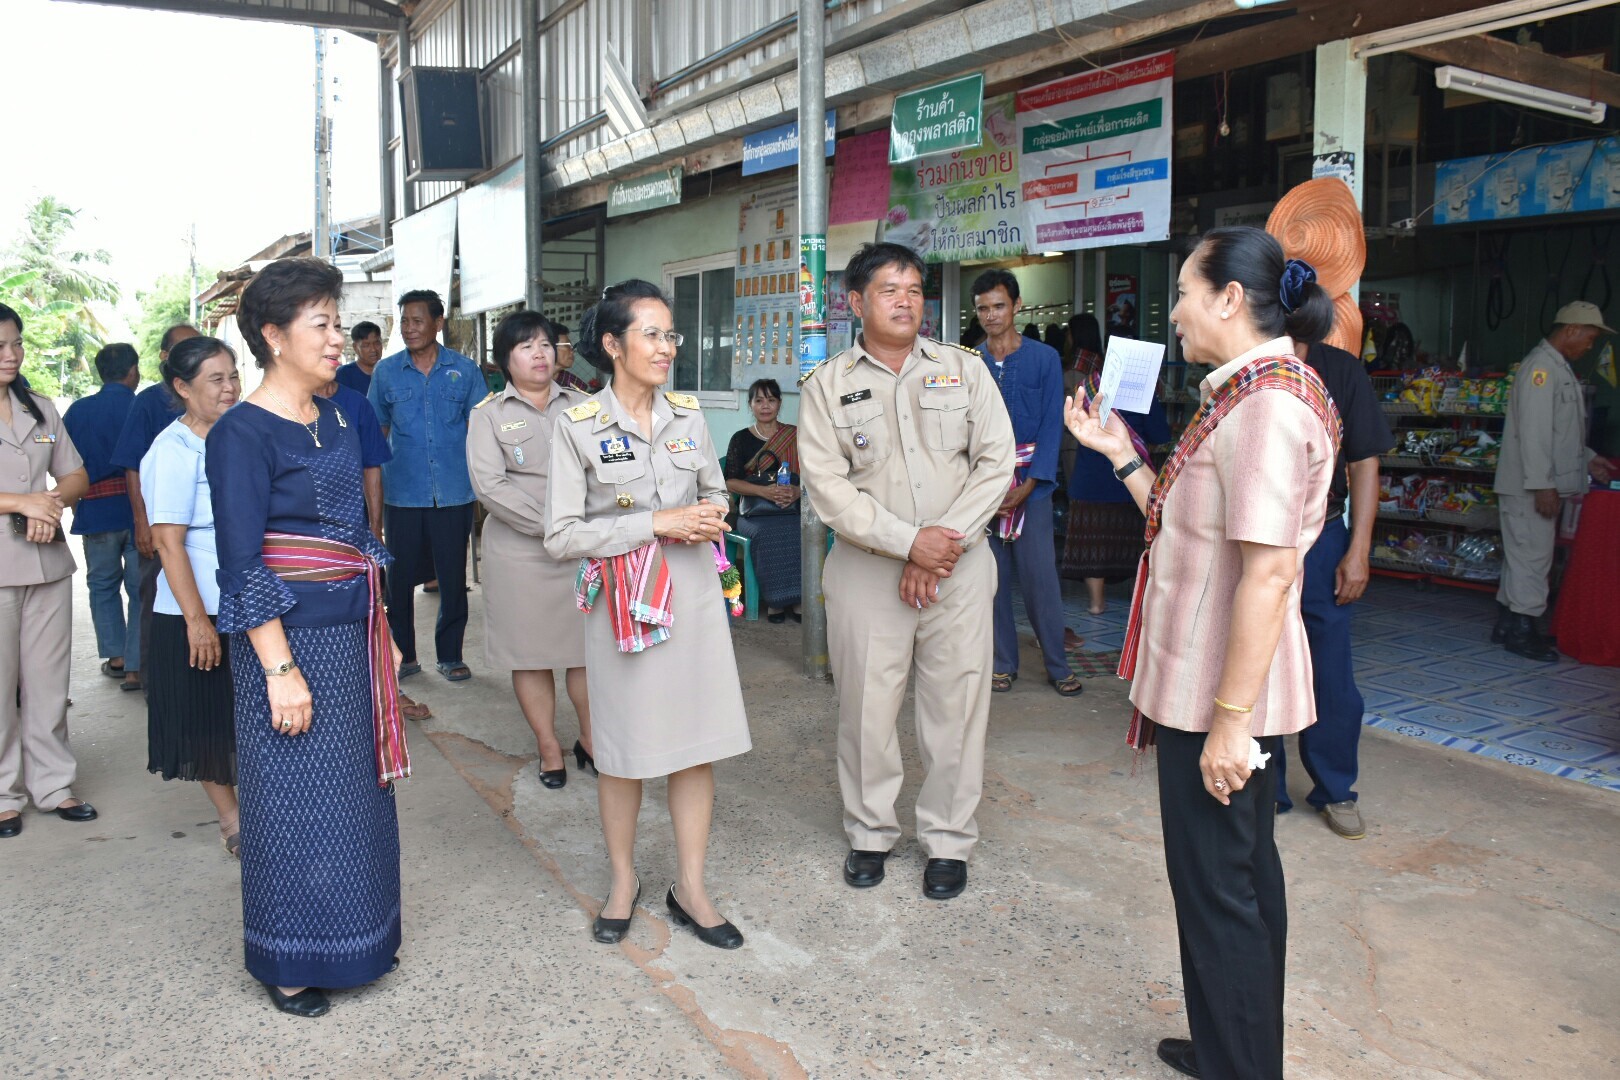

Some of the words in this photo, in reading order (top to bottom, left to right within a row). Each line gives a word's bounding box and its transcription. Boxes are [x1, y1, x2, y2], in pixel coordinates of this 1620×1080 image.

[916, 92, 953, 120] ร้านค้า
[1032, 111, 1149, 149] กลุ่มออมทรัพย์เพื่อการผลิต
[917, 151, 1013, 188] ร่วมกันขาย
[934, 182, 1016, 218] ปันผลกำไร
[930, 220, 1021, 251] ให้กับสมาชิก
